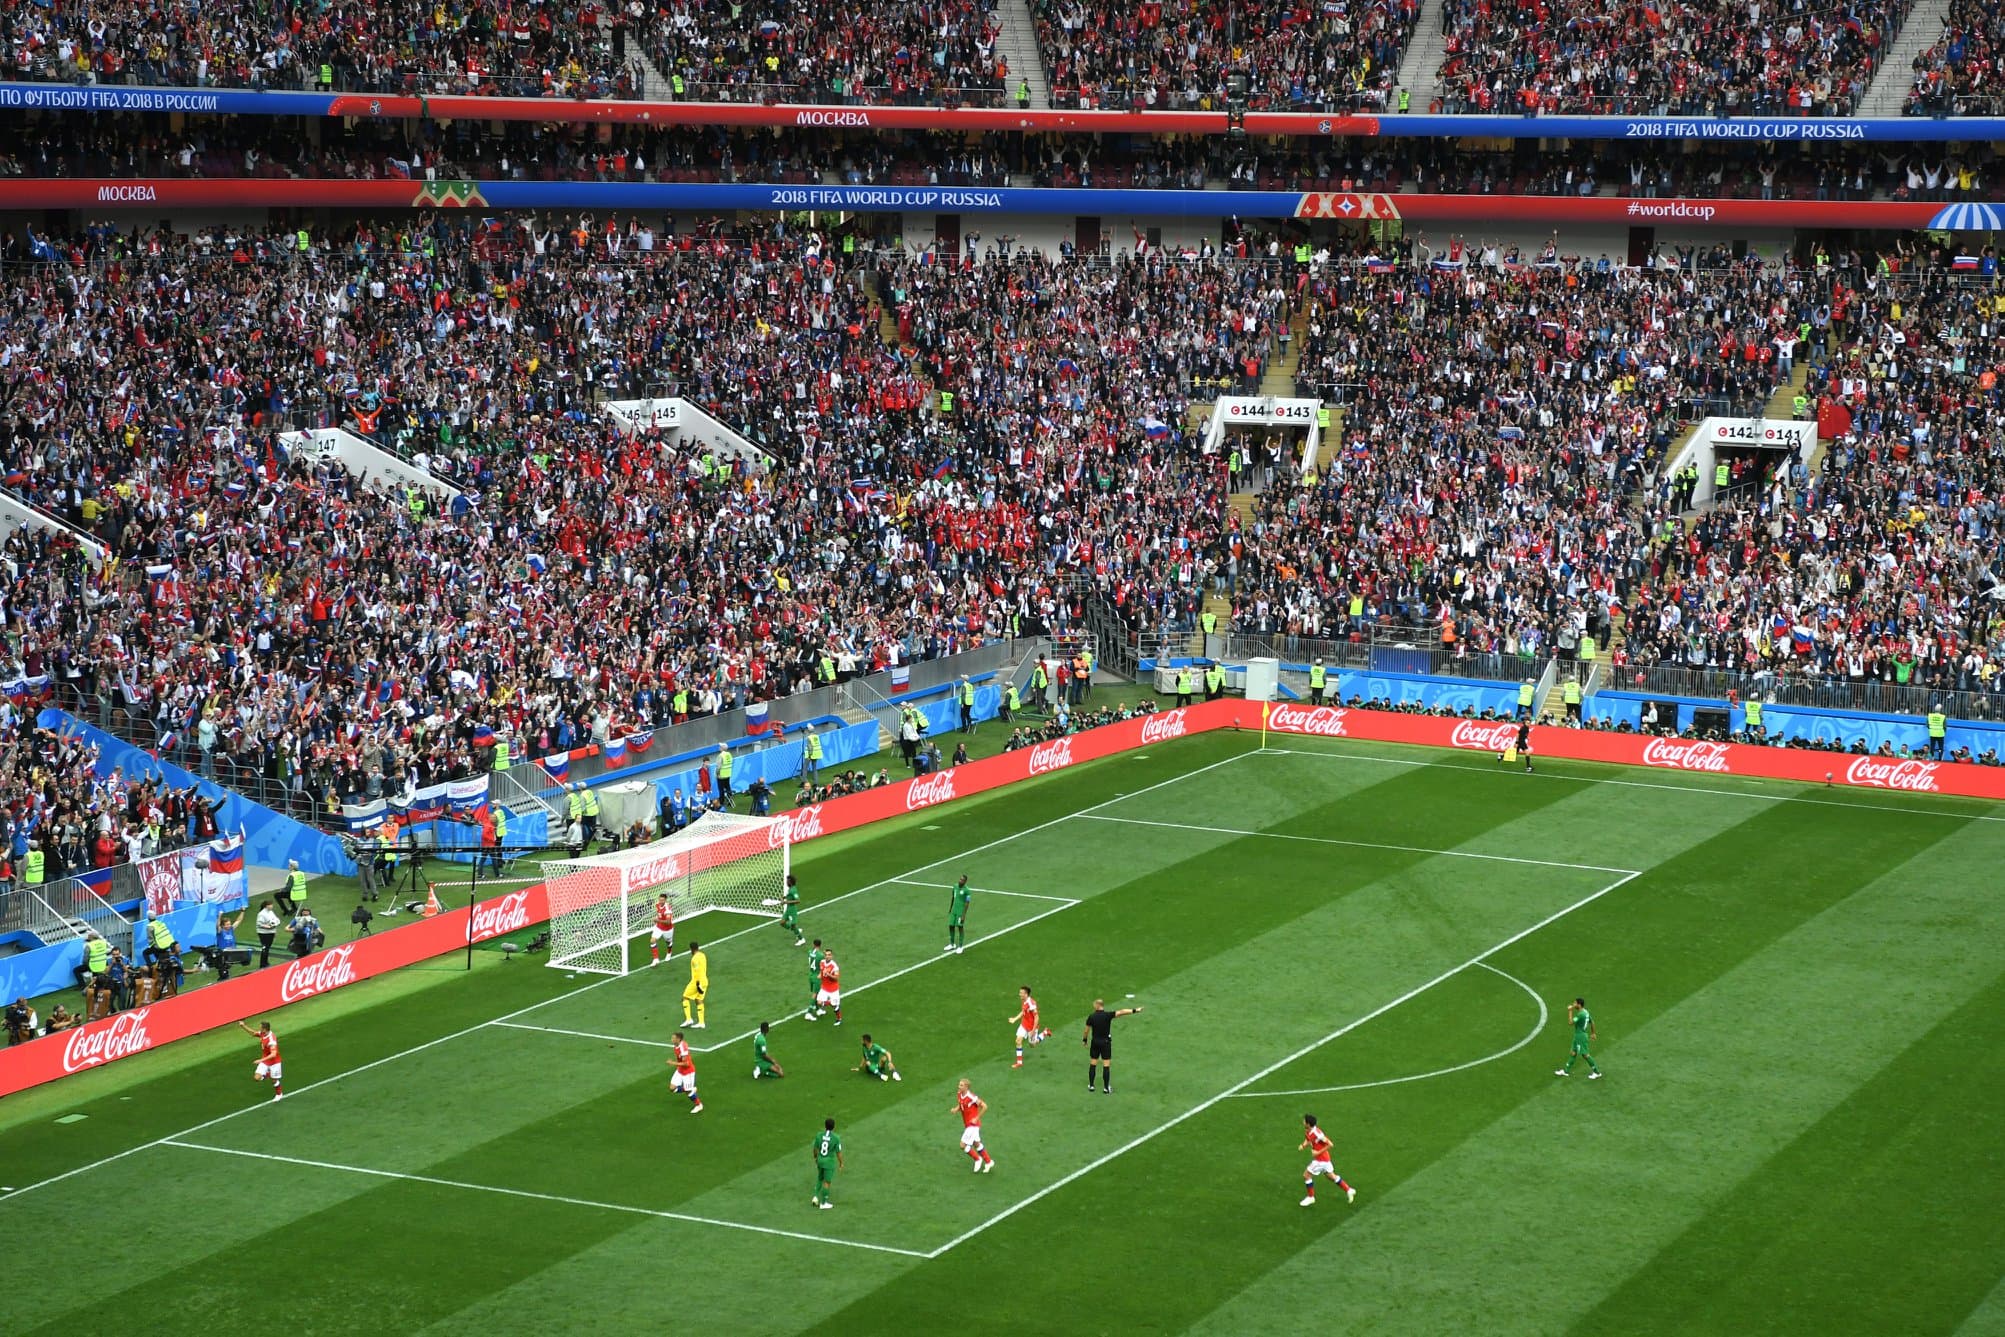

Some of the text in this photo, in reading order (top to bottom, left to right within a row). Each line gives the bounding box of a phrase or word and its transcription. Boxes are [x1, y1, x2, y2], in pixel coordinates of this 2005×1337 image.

[1, 89, 217, 110] ПО ФУТБОЛУ FIFA 2018 В РОССИИ
[797, 111, 870, 126] МОСКВА
[1627, 123, 1864, 138] 2018 FIFA WORLD CUP RUSSIA
[98, 186, 156, 201] МОСКВА
[772, 190, 1001, 206] 2018 FIFA WORLD CUP RUSSIA
[1627, 201, 1715, 221] #worldcup
[657, 407, 676, 419] 145
[1287, 407, 1310, 417] 143
[1729, 427, 1753, 439] 142
[318, 439, 335, 452] 147
[1142, 709, 1186, 743] Coca-Cola
[1269, 704, 1347, 734] Coca-Cola
[1451, 720, 1534, 752] Coca-Co
[1030, 737, 1072, 774] Coca-Cola
[1643, 738, 1730, 771] Coca-Cola
[1847, 755, 1939, 790] Coca-Cola
[907, 769, 955, 810] Coca-Cola
[466, 890, 528, 942] Coca-Cola
[282, 944, 355, 1001] Coca-Cola
[63, 1008, 149, 1072] Coca-Cola
[820, 1141, 829, 1156] 8
